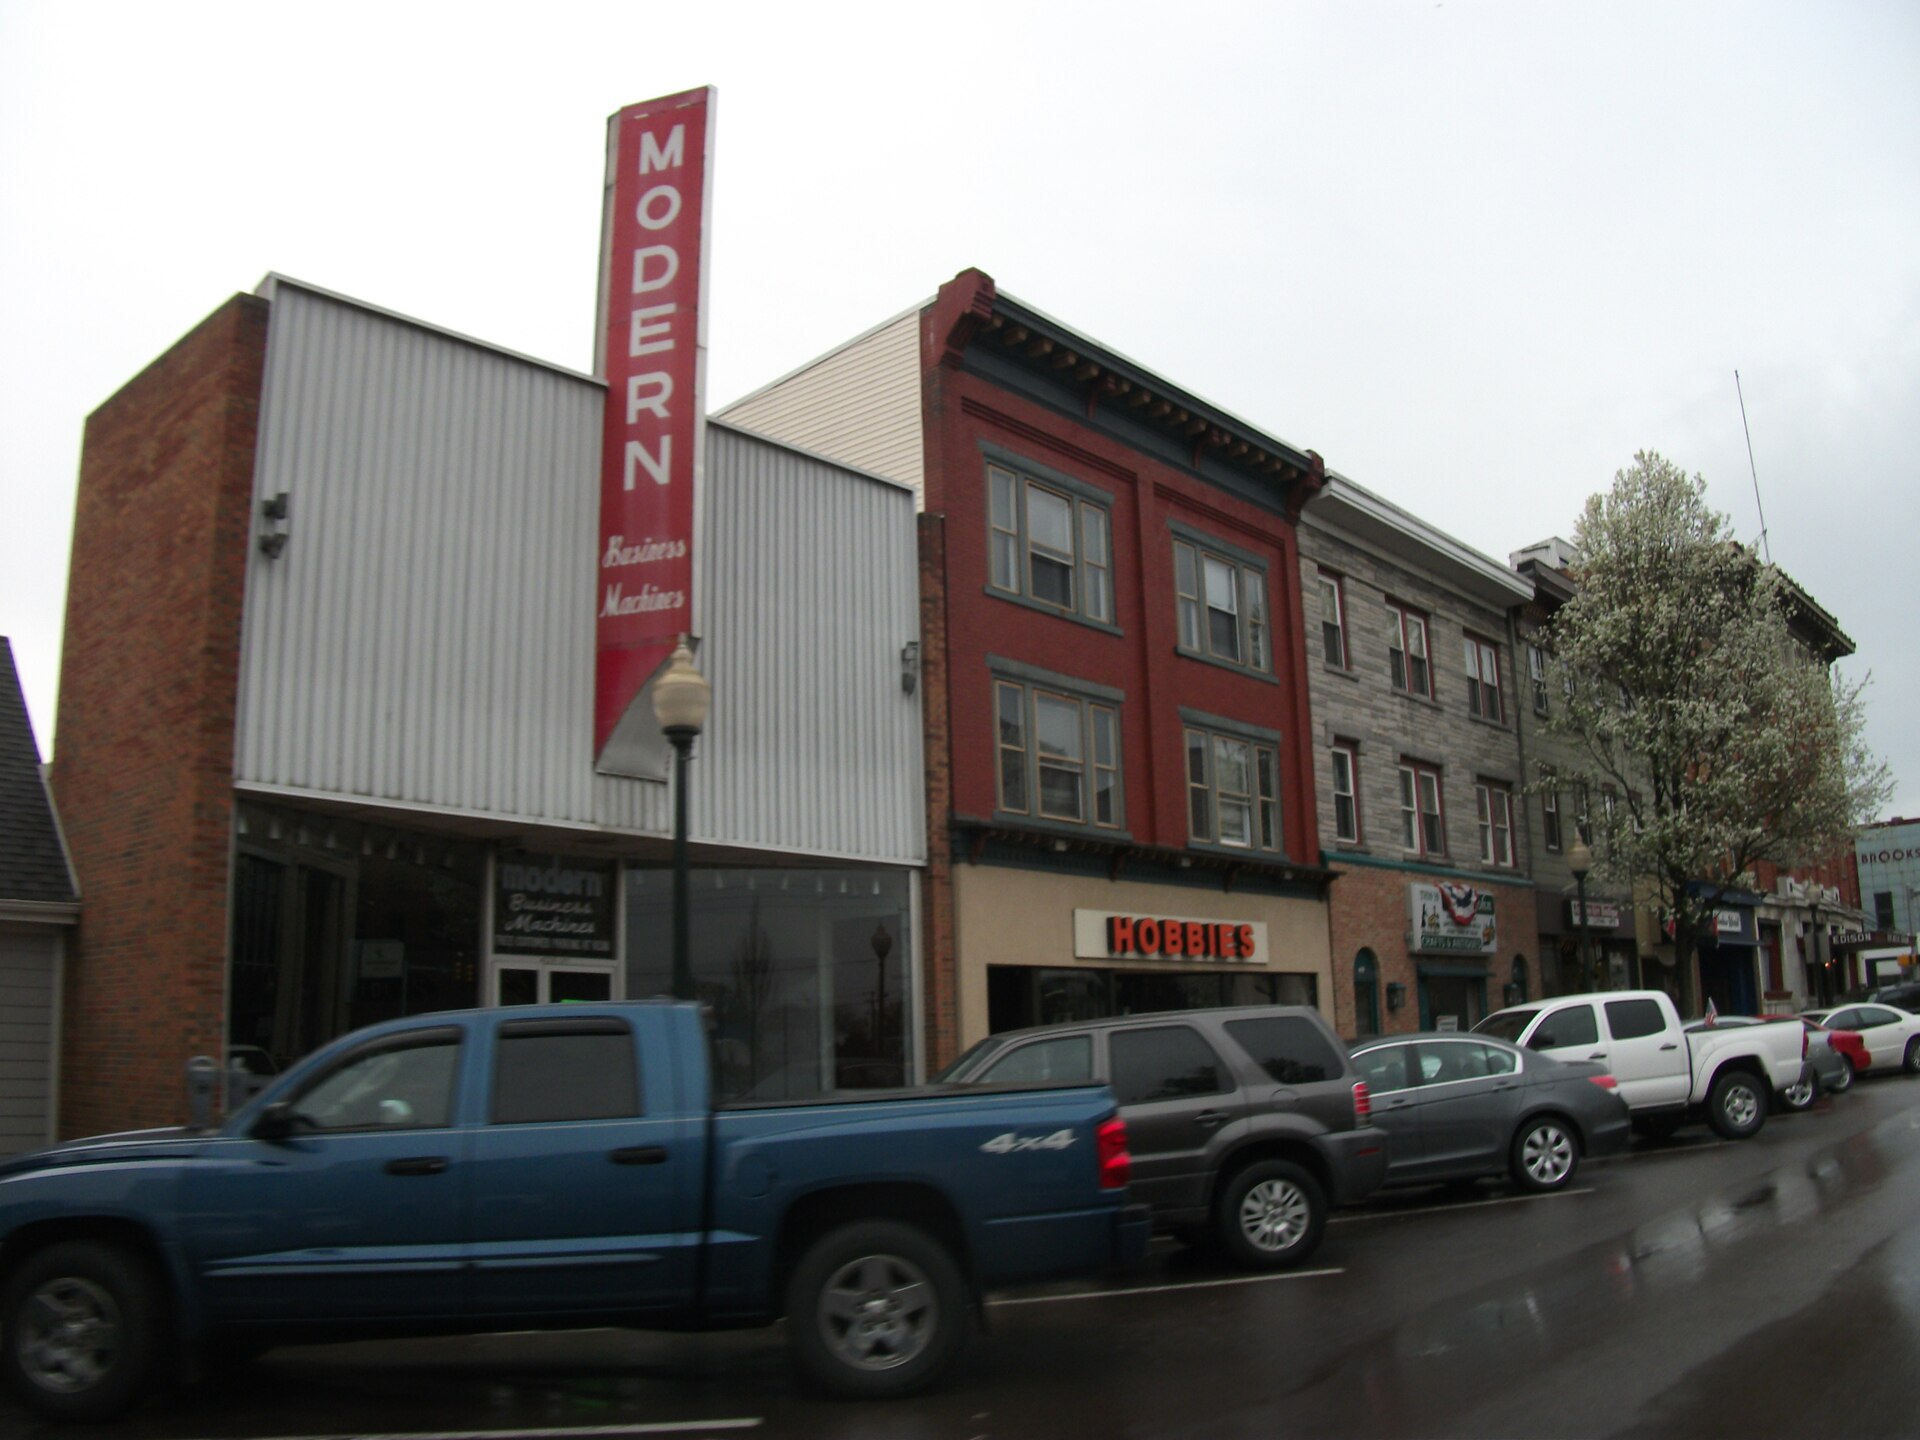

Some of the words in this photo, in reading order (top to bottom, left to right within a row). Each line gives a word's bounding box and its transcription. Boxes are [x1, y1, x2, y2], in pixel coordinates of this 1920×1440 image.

[623, 124, 685, 490] MODERN
[602, 535, 686, 568] Business
[598, 582, 685, 618] Machines
[1861, 848, 1920, 864] BROOKS
[509, 893, 593, 914] Business
[504, 914, 596, 934] Machines
[1107, 916, 1256, 959] HOBBIES
[1833, 932, 1872, 945] EDISON
